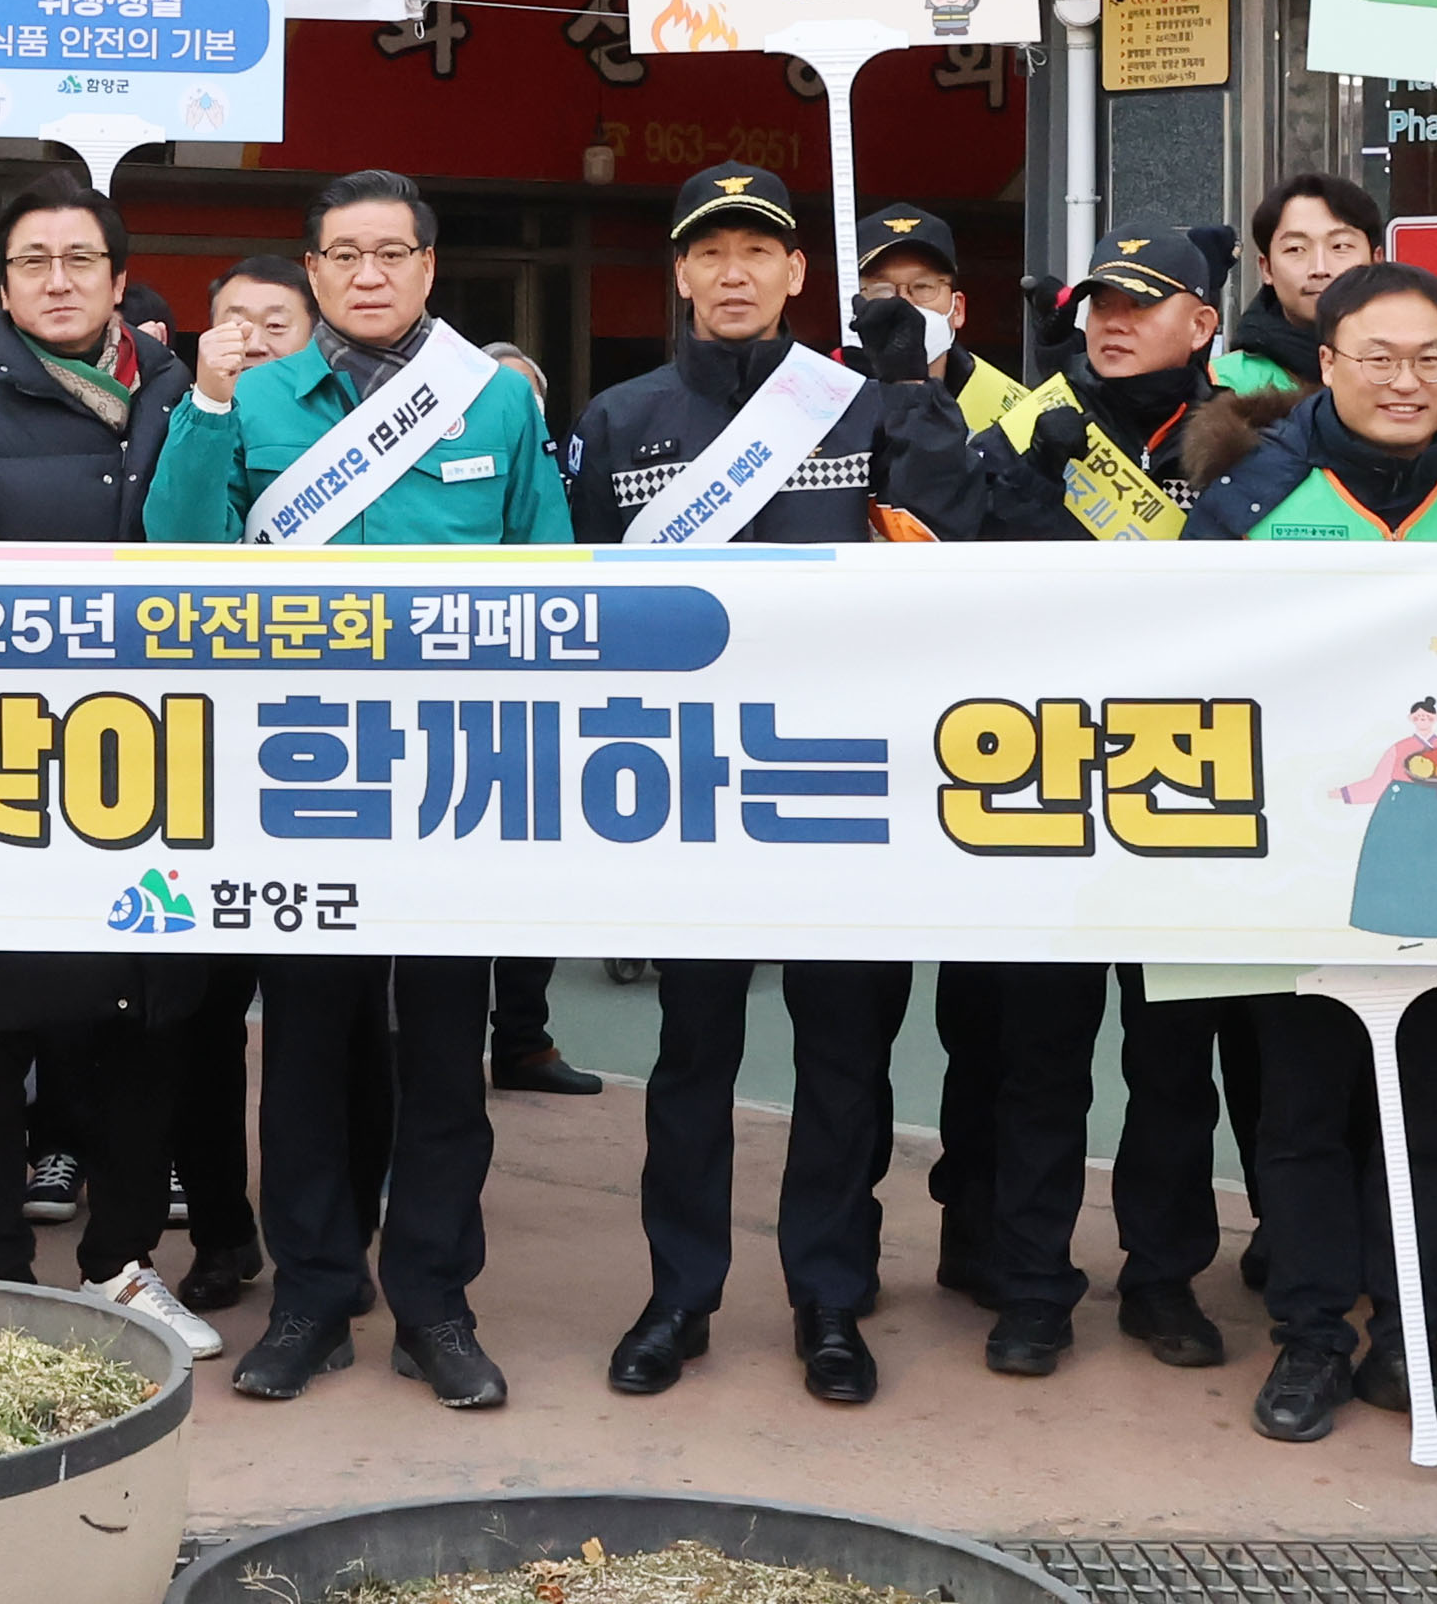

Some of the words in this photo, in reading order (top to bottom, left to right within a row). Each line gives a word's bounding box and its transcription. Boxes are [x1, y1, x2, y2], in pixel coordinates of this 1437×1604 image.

[60, 25, 160, 60] 안전의
[170, 27, 237, 62] 기본
[85, 77, 130, 95] 함양군
[366, 382, 439, 457] 대국민
[271, 446, 371, 540] 안전문화
[726, 439, 774, 488] 생활
[136, 593, 393, 660] 안전문화
[408, 593, 600, 661] 캠페인
[257, 695, 889, 845] 함께하는
[934, 697, 1268, 858] 안전
[211, 879, 359, 932] 함양군
